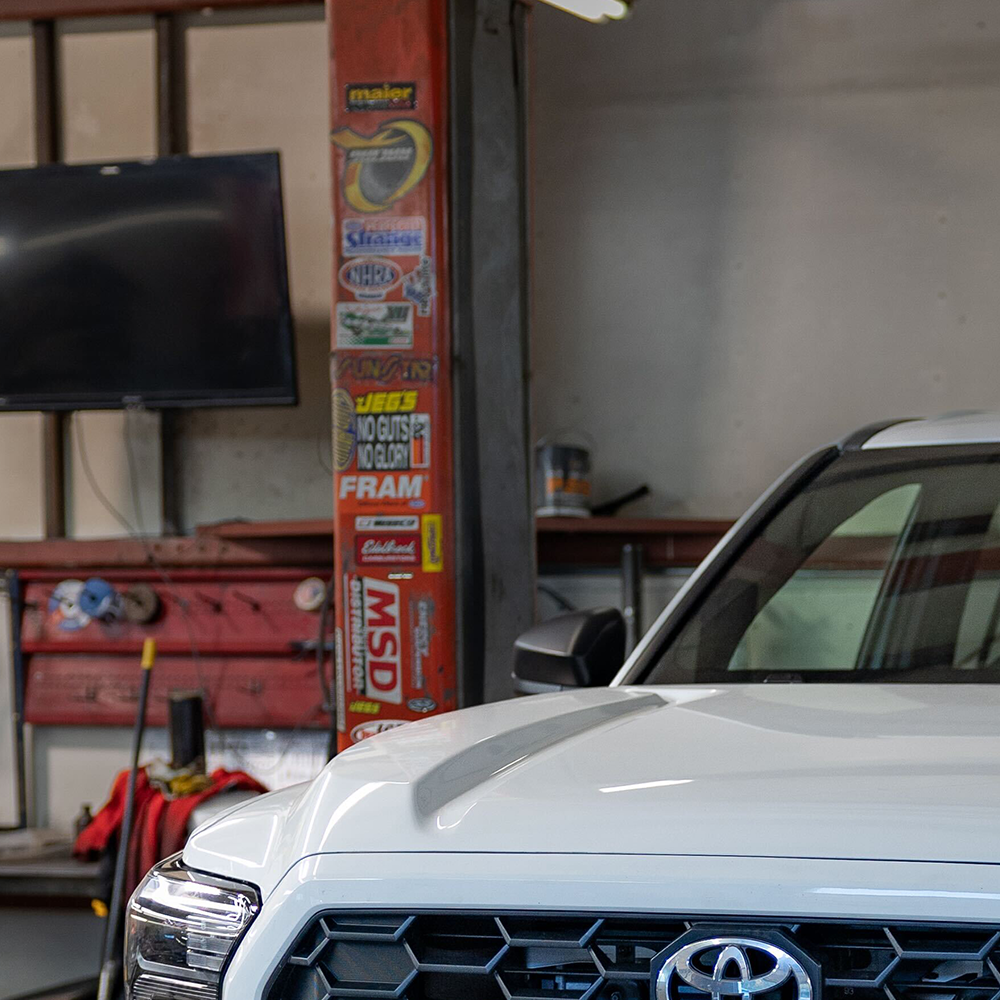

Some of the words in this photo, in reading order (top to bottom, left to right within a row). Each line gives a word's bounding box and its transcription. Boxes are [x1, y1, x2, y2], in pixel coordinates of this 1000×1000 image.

[350, 83, 412, 100] maier
[348, 265, 393, 285] NHRA
[357, 415, 375, 441] NO
[377, 415, 410, 440] GUTS
[357, 443, 374, 470] NO
[375, 443, 410, 469] GLORY
[339, 475, 423, 499] FRAM
[366, 588, 398, 692] MSD
